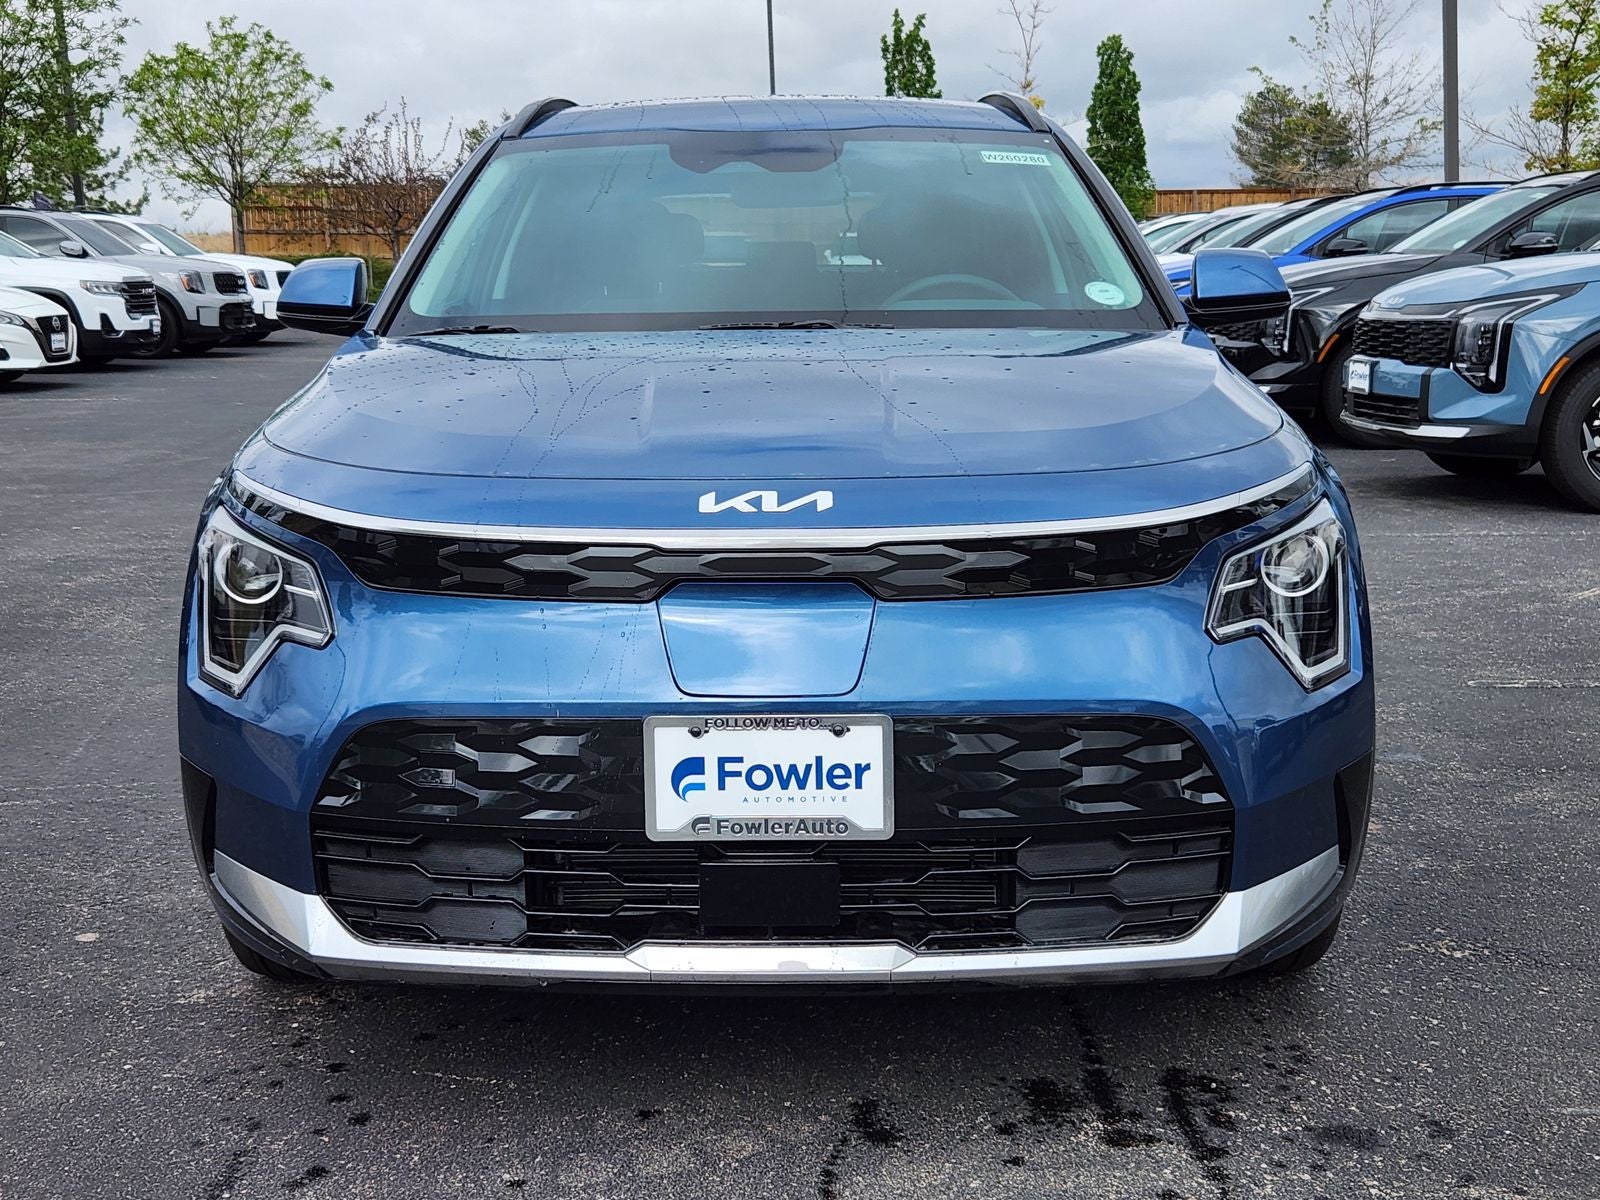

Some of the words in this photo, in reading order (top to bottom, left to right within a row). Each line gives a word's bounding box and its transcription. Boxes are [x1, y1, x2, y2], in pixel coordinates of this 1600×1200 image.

[699, 490, 833, 513] KIA
[704, 717, 769, 729] FOLLOW
[773, 717, 795, 728] ME
[717, 755, 871, 791] Fowler
[742, 795, 848, 803] AUTOMOTIVE
[716, 818, 849, 835] FowlerAuto
